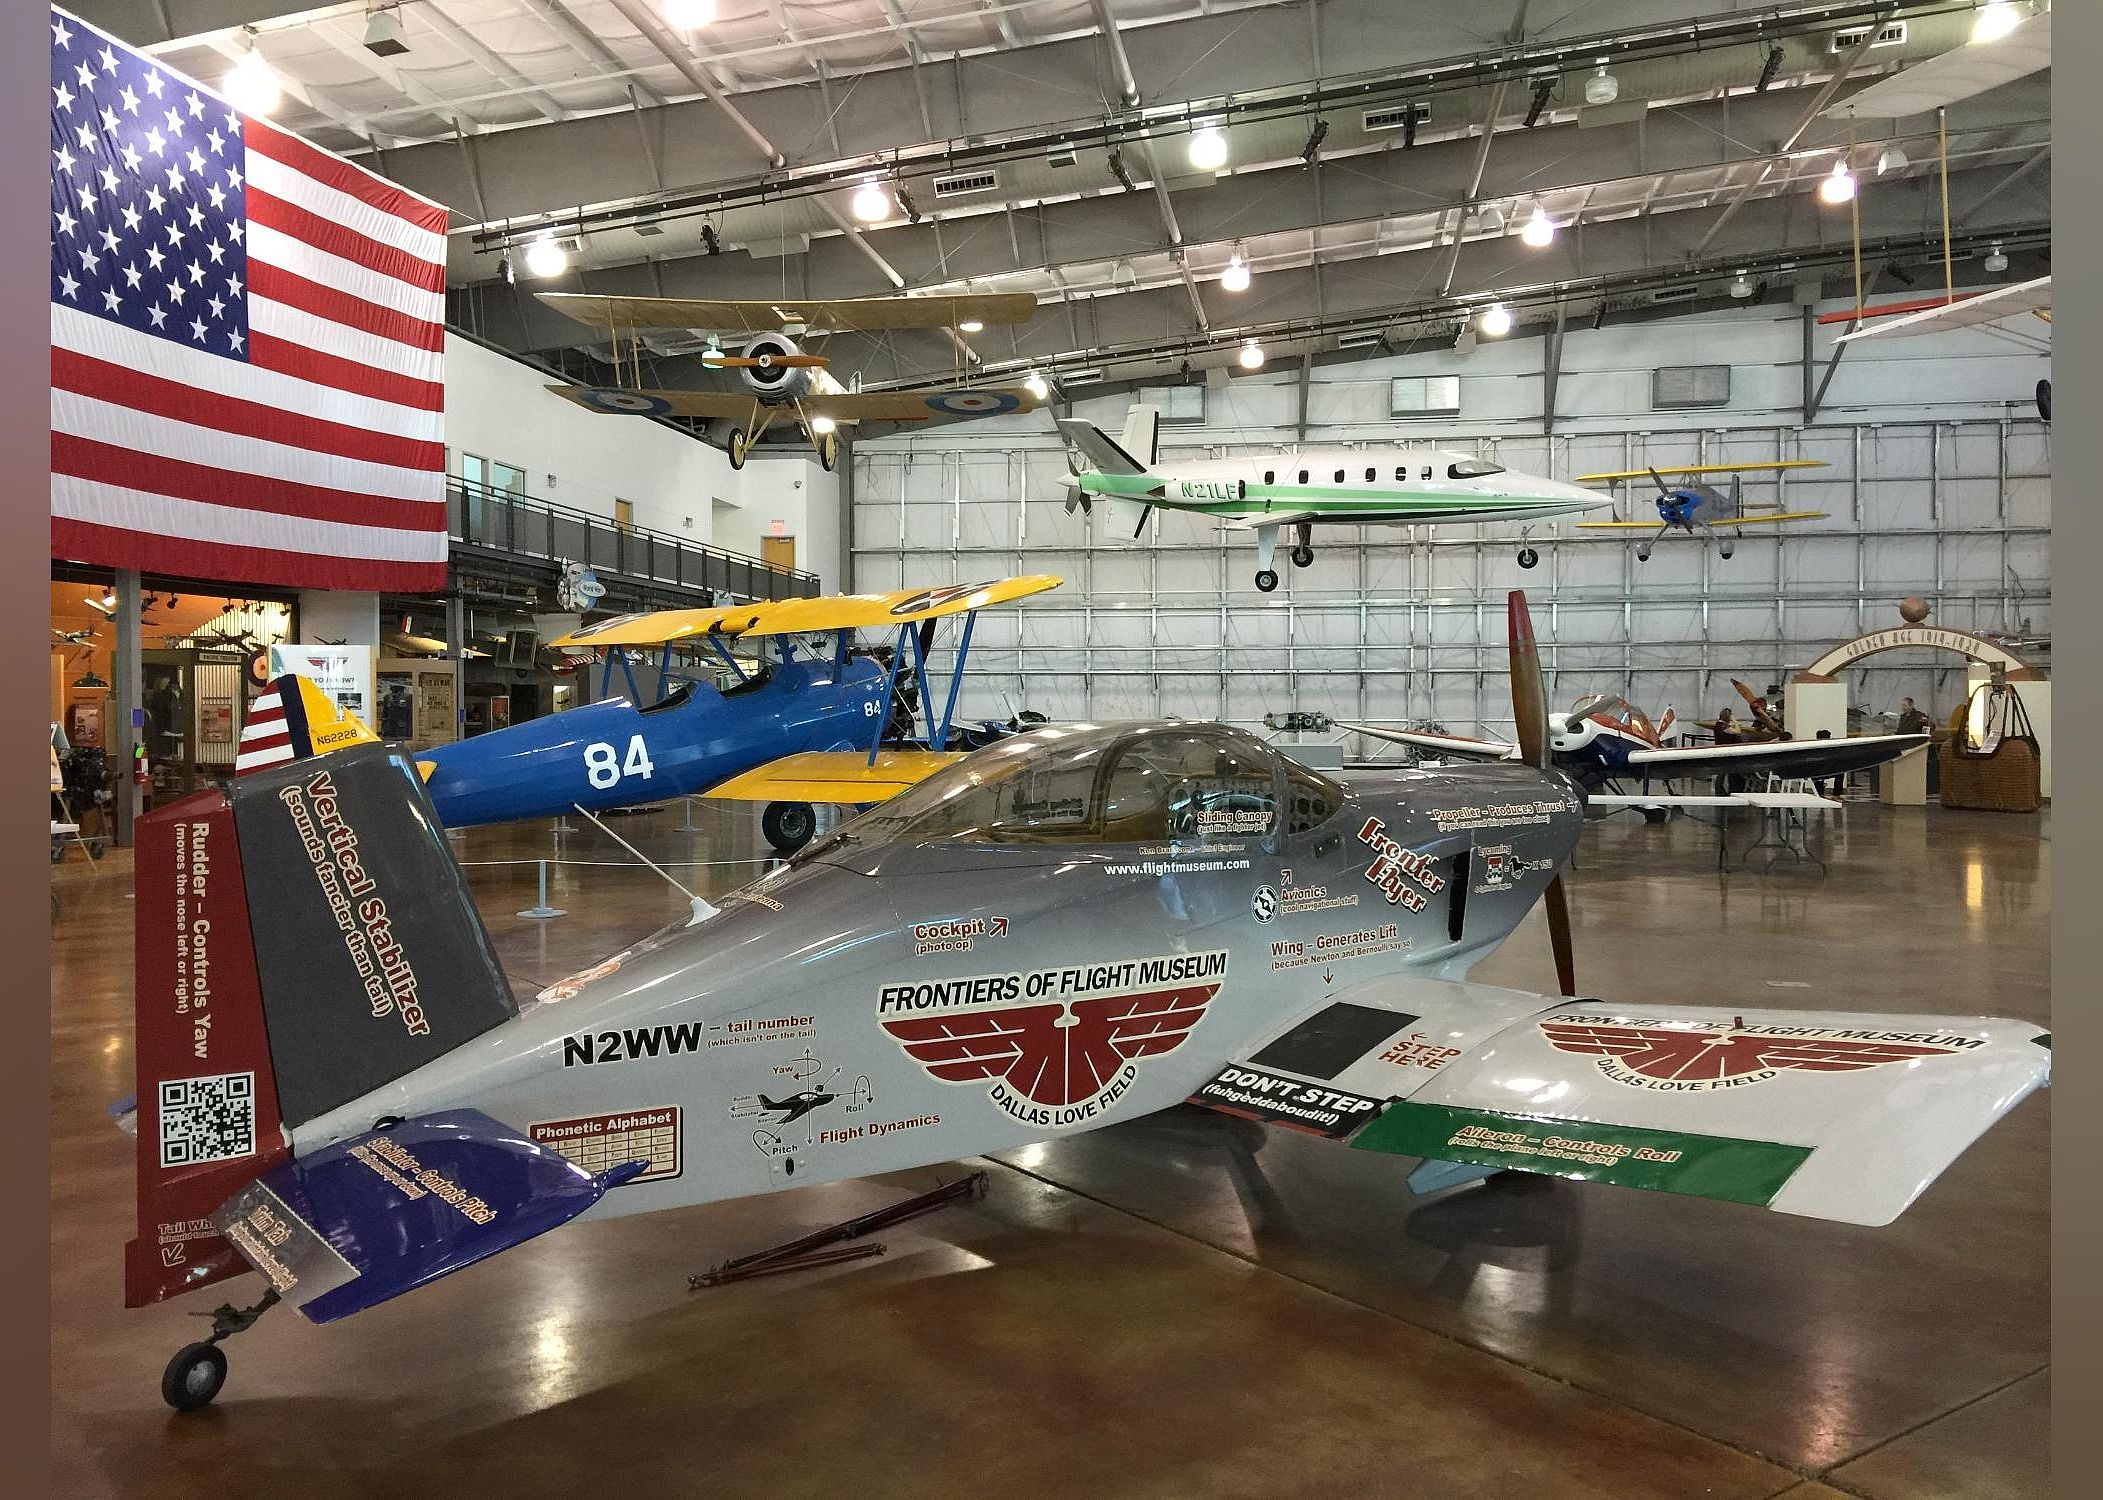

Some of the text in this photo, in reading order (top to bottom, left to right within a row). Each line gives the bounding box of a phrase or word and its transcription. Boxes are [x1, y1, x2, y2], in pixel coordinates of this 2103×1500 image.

[1181, 482, 1236, 499] N21LF
[864, 700, 882, 717] 84
[317, 728, 358, 746] N62228
[583, 734, 655, 790] 84
[1197, 810, 1273, 824] Sliding Canopy
[1433, 806, 1481, 820] Propeller
[1487, 804, 1534, 817] Produces
[1533, 801, 1565, 815] Thrust
[192, 823, 210, 897] Rudder
[1104, 858, 1250, 876] www.flightmuseum.com
[1281, 885, 1327, 901] Avionics
[1365, 854, 1427, 913] Flyer
[279, 785, 394, 1017] (sounds fancier than tail)
[307, 770, 376, 897] Vertical
[358, 898, 430, 1036] Stabilizer
[1280, 903, 1298, 915] (cool
[1299, 899, 1341, 912] navigational
[173, 823, 189, 1014] (moves the nose left or right)
[914, 919, 985, 939] Cockpit
[914, 939, 974, 955] (photo op)
[1271, 940, 1303, 957] Wing
[1316, 931, 1376, 949] Generates
[1379, 923, 1398, 939] Lift
[193, 919, 211, 1008] Controls
[1271, 956, 1309, 971] (because
[1310, 952, 1340, 964] Newton
[1341, 950, 1355, 959] and
[878, 952, 1227, 1014] FRONTIERS OF FLIGHT MUSEUM
[194, 1013, 211, 1059] Yaw
[563, 1022, 702, 1068] N2WW
[727, 1019, 752, 1033] tail
[757, 1015, 815, 1031] number
[707, 1029, 817, 1049] (which isn't on the tail)
[1830, 1029, 1986, 1049] MUSEUM
[1392, 1041, 1462, 1058] STEP
[772, 1065, 794, 1075] Yaw
[1378, 1051, 1446, 1070] HERE
[1597, 1058, 1777, 1091] DALLAS LOVE FIELD
[990, 1064, 1137, 1126] DALLAS LOVE FIELD
[1217, 1068, 1375, 1115] DON'T STEP
[846, 1104, 864, 1114] Roll
[536, 1111, 672, 1139] Phonetic Alphabet
[820, 1113, 941, 1145] Flight Dynamics
[772, 1144, 798, 1156] Pitch
[1455, 1126, 1527, 1143] Aileron
[1542, 1135, 1631, 1157] Controls
[1632, 1147, 1682, 1163] Roll
[415, 1169, 467, 1208] Controls
[460, 1196, 498, 1225] Pitch
[158, 1221, 186, 1235] Tail
